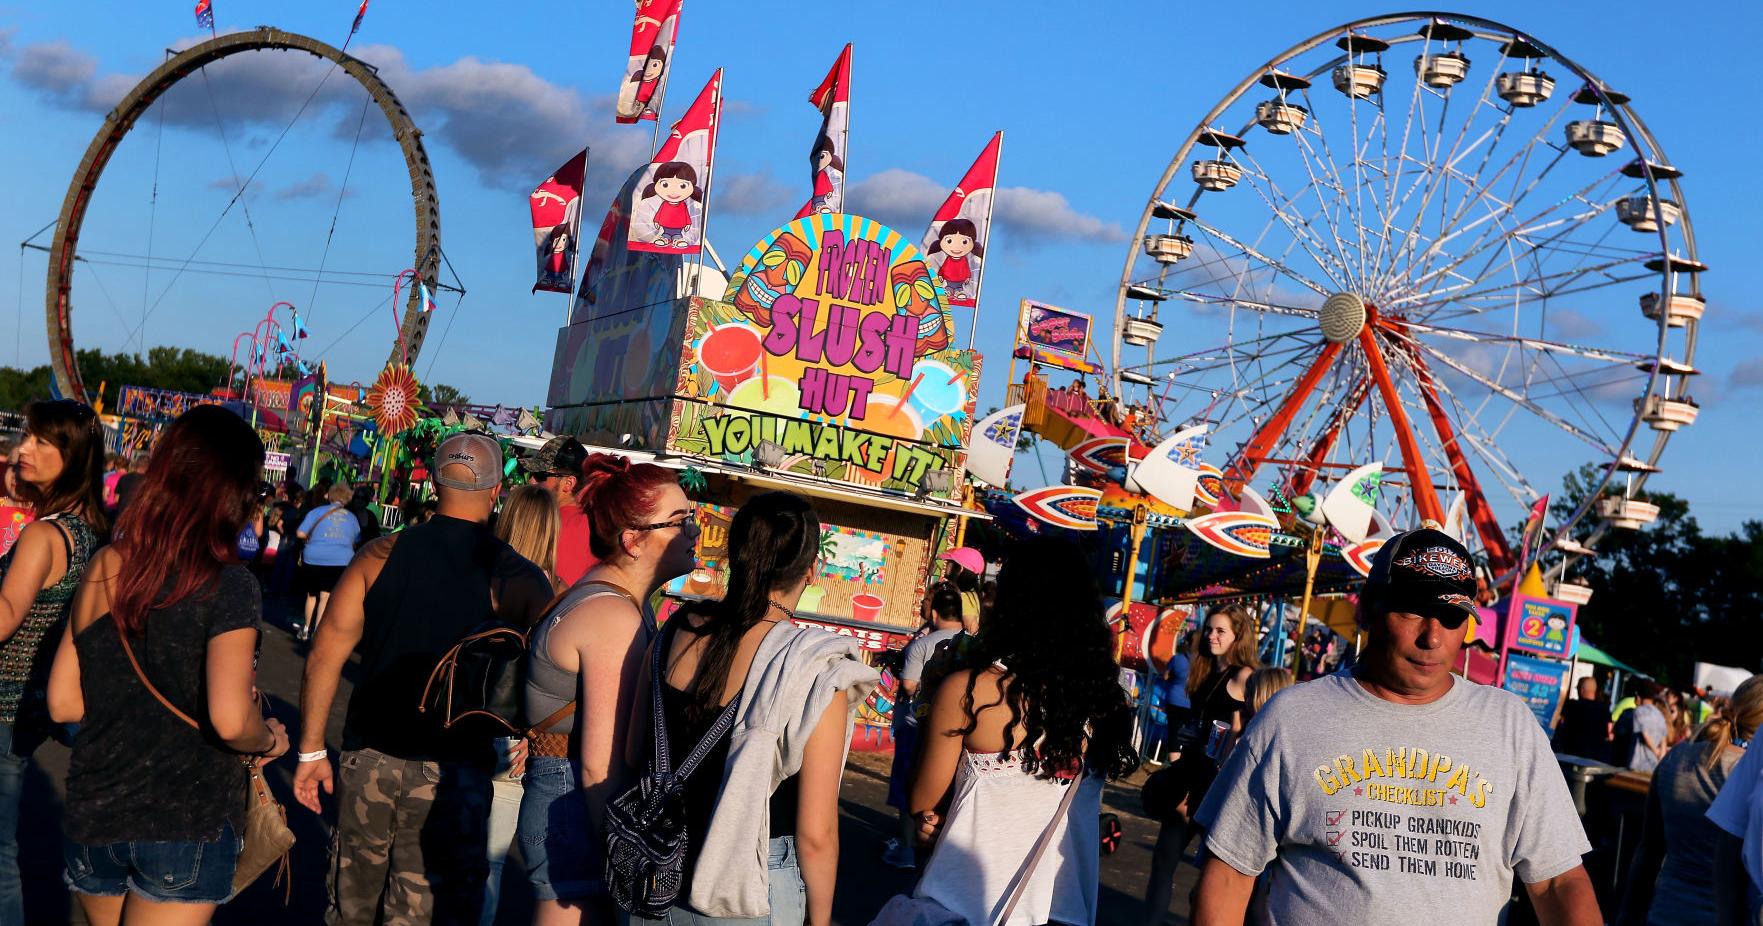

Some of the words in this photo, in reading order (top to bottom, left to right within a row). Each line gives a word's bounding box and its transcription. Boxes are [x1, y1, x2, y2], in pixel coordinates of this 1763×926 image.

[815, 229, 891, 305] FROZEN
[762, 293, 920, 380] SLUSH
[798, 367, 875, 421] HUT
[702, 414, 777, 456] YOU
[782, 419, 893, 472] MAKE
[1184, 449, 1190, 457] 5
[1527, 620, 1541, 637] 2
[1313, 746, 1494, 809] GRANDPA'S
[1366, 782, 1448, 807] CHECKLIST
[1351, 810, 1401, 830] PICKUP
[1407, 816, 1482, 839] GRANDKIDS
[1351, 830, 1388, 850] SPOIL
[1394, 834, 1428, 855] THEM
[1435, 839, 1480, 860] ROTTEN
[1351, 851, 1390, 870] SEND
[1398, 856, 1437, 877] THEM
[1445, 861, 1477, 880] HOME
